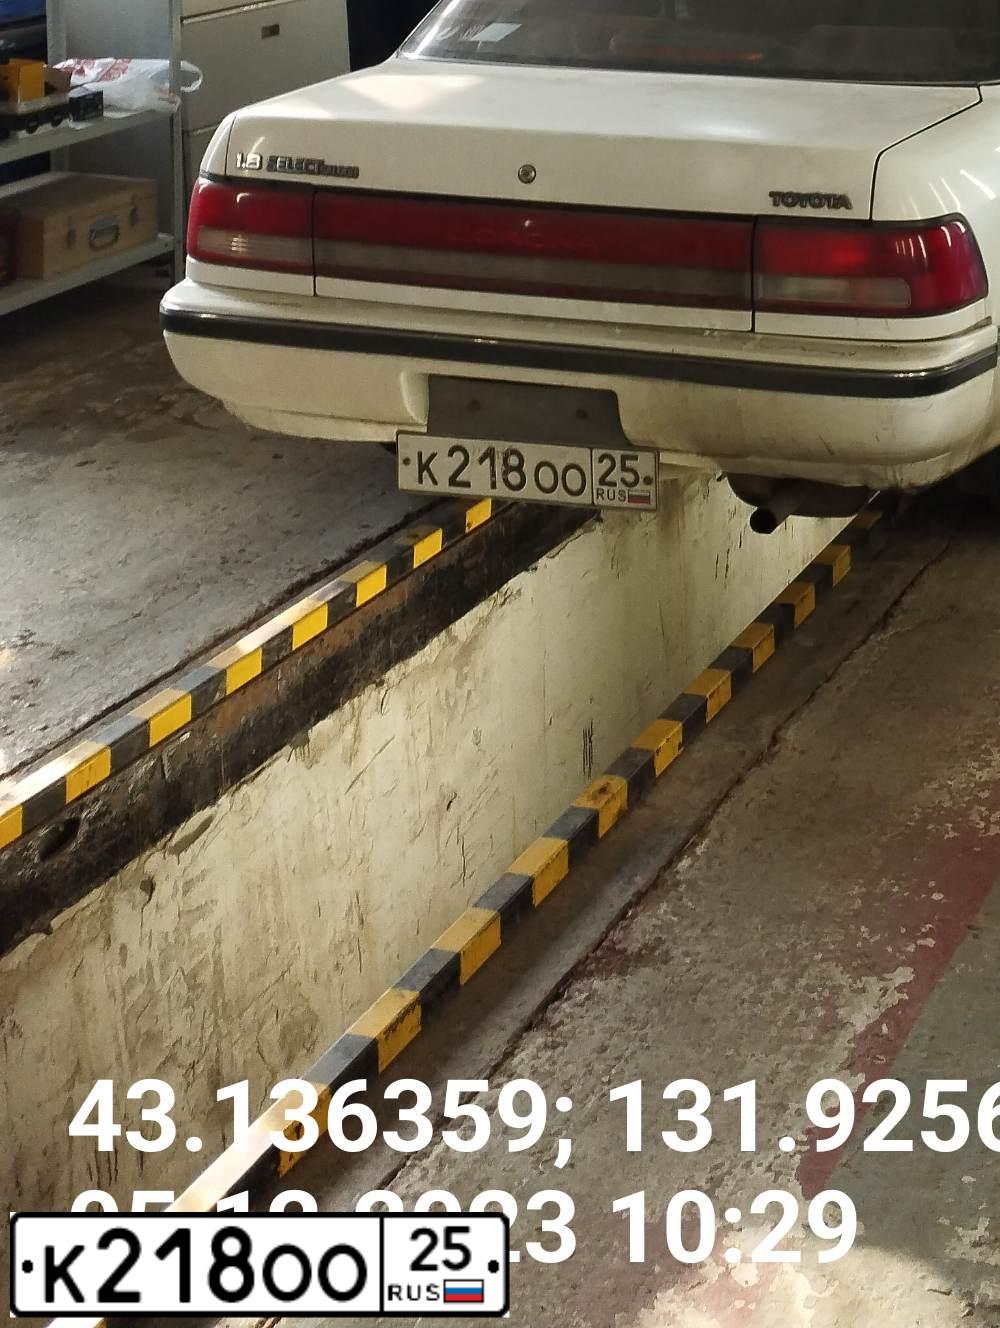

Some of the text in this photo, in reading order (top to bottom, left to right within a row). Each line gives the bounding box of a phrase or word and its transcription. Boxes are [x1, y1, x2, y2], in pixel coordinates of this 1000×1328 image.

[768, 190, 853, 210] TOYOTA
[597, 453, 641, 489] 25
[595, 487, 628, 502] RUS
